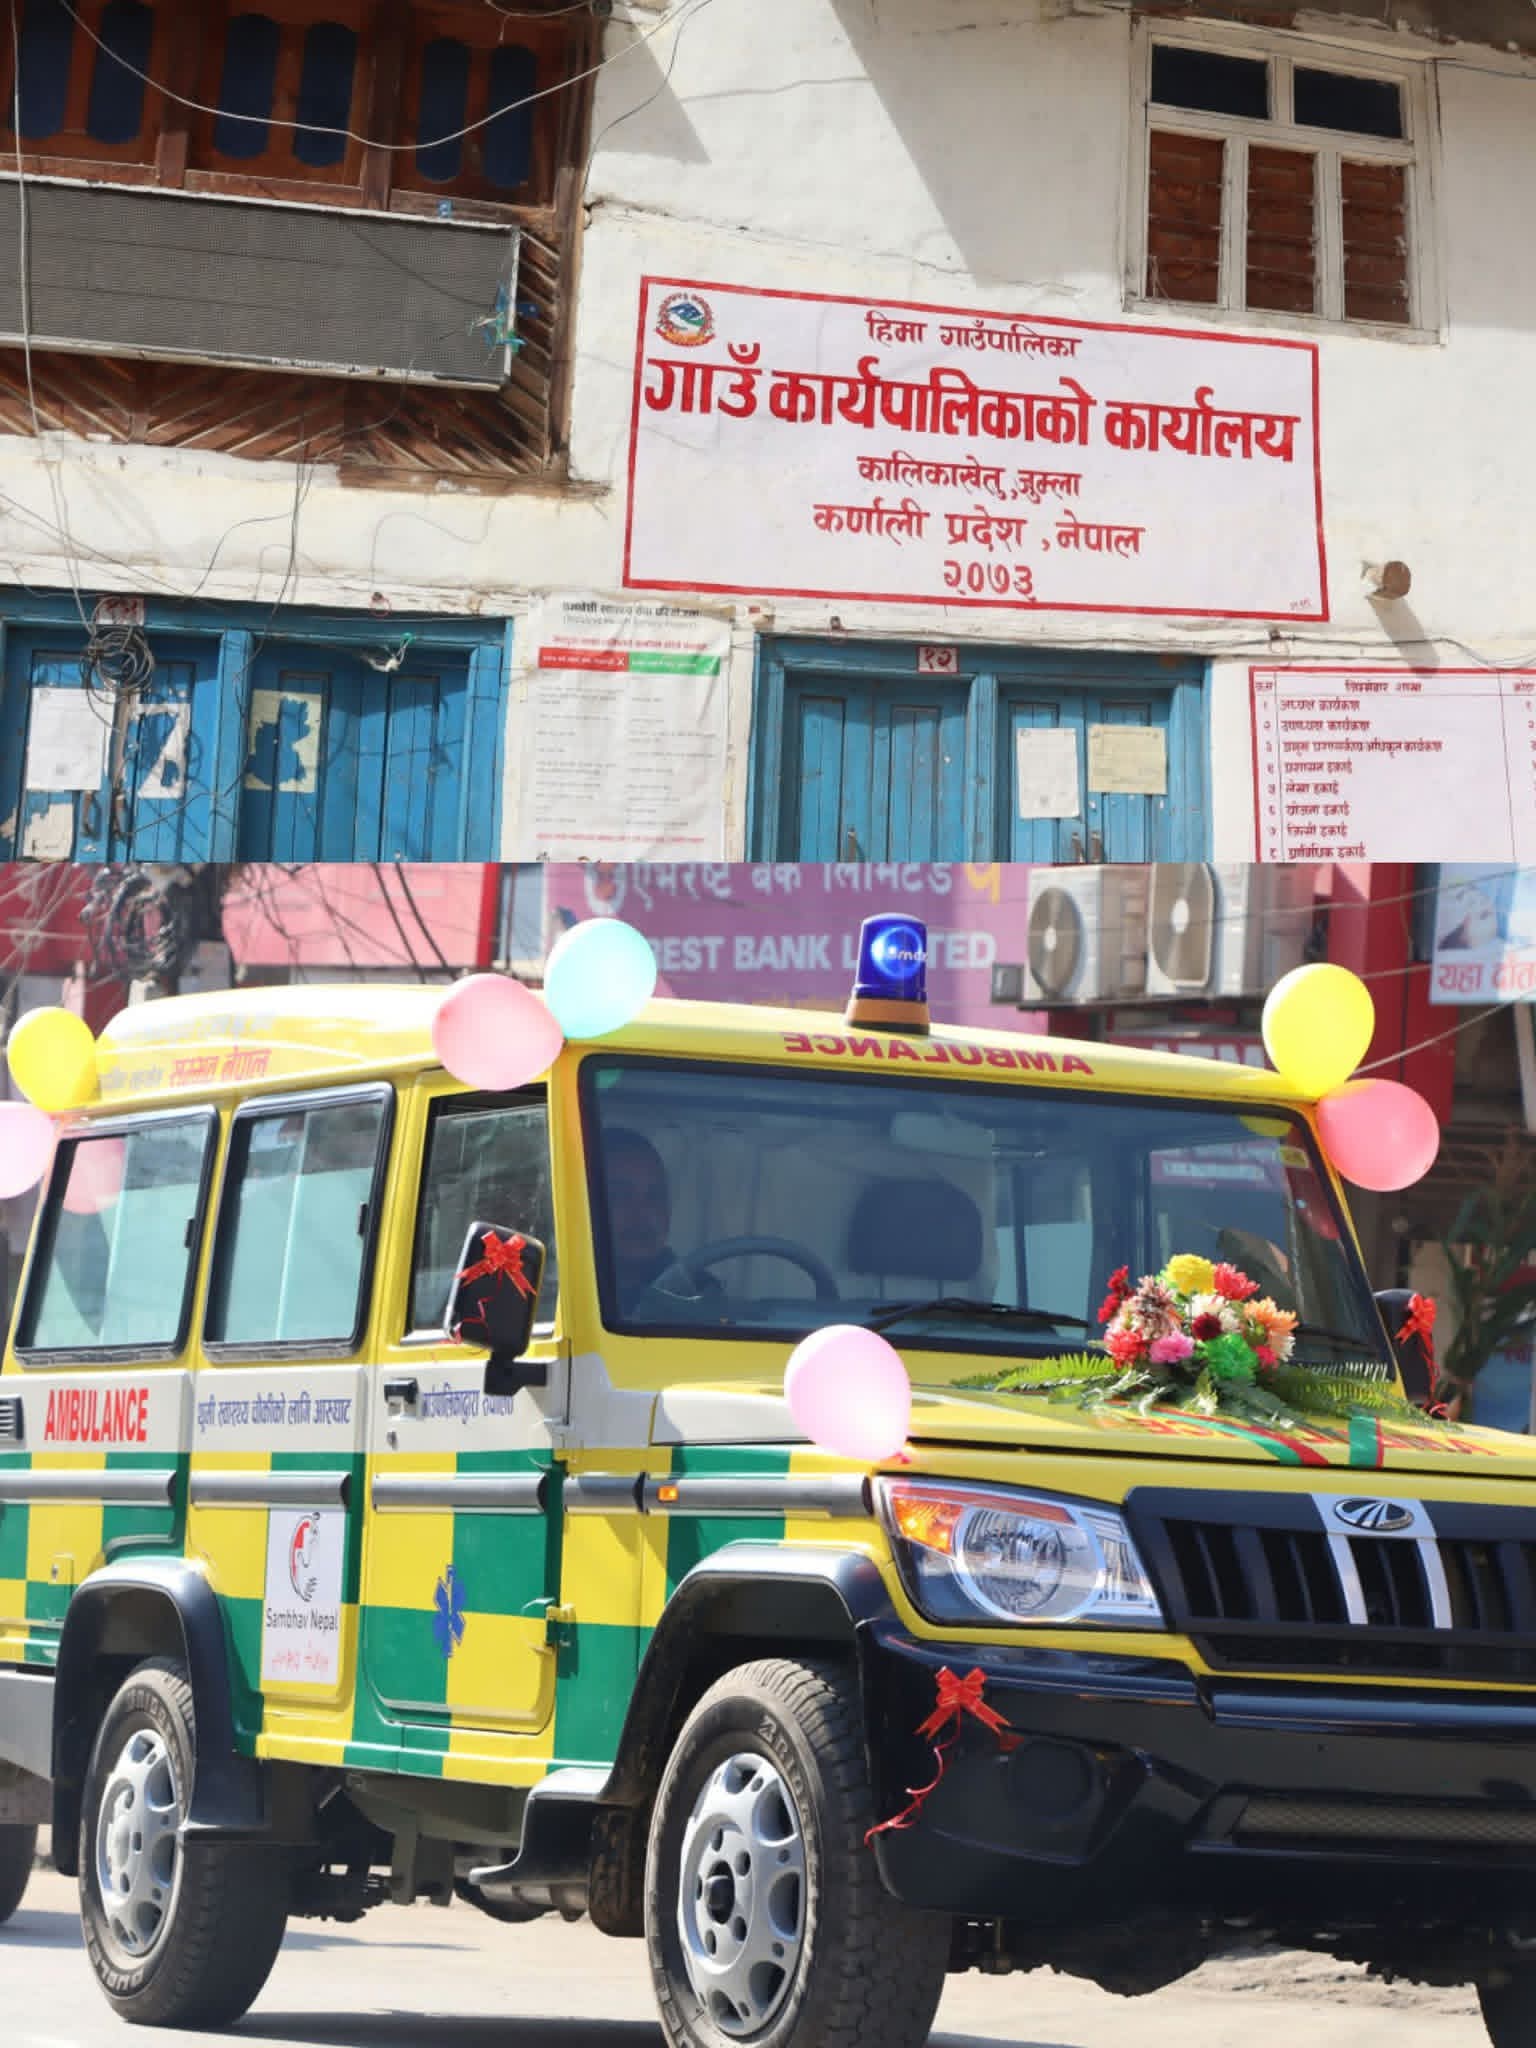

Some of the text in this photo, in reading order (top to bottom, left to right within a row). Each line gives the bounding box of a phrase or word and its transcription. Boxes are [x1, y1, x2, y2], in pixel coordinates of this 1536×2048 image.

[864, 309, 1082, 358] हिमा गाउँपालिका
[644, 341, 1303, 463] गाउँ कार्यपालिकाको कार्यालय
[813, 496, 931, 546] कर्णाली
[944, 504, 1028, 552] प्रदेश
[943, 560, 1037, 602] २०७३
[735, 936, 832, 971] BANK
[45, 1388, 150, 1442] AMBULANCE
[266, 1607, 338, 1636] Sambhav Nepal
